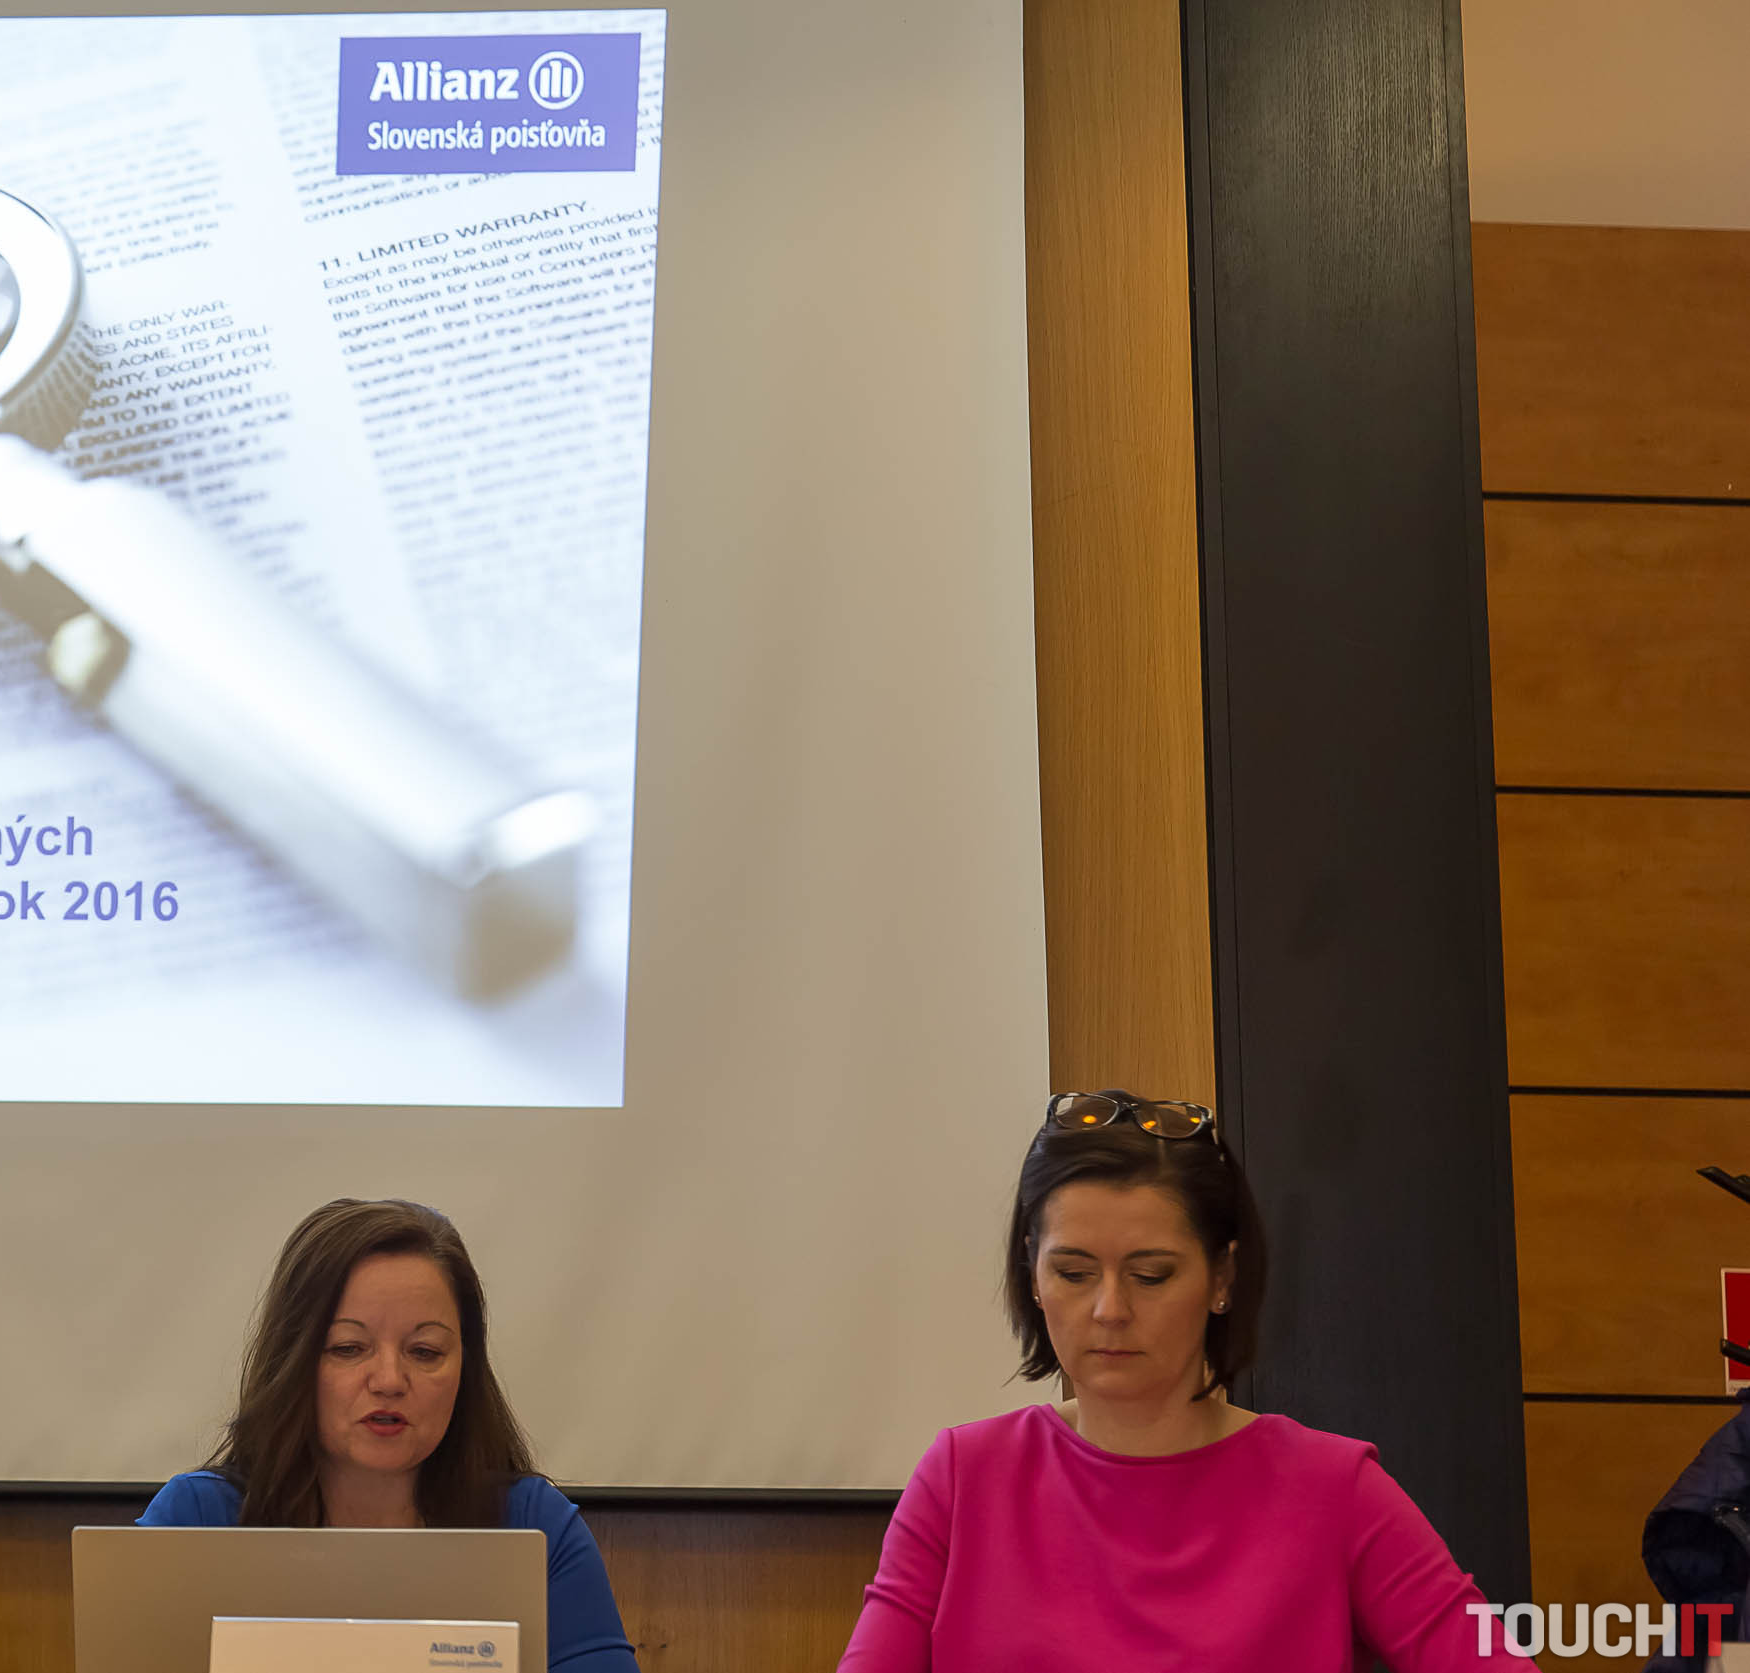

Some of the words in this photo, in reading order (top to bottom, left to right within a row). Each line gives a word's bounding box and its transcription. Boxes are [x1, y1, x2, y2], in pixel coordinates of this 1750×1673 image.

[369, 61, 519, 101] Allianz
[368, 119, 483, 151] Slovenská
[490, 118, 606, 155] poisťovňa
[305, 188, 439, 222] communications
[323, 269, 381, 288] Except
[388, 264, 406, 273] as
[413, 254, 447, 267] may
[454, 248, 476, 258] be
[482, 229, 562, 251] otherwise
[570, 210, 642, 234] provided
[358, 234, 448, 261] LIMITED
[328, 290, 370, 304] rants
[376, 285, 393, 293] to
[399, 277, 425, 288] the
[432, 256, 508, 280] individual
[539, 242, 582, 256] entity
[590, 232, 621, 245] that
[333, 310, 359, 321] the
[365, 291, 440, 313] Software
[447, 284, 466, 293] for
[475, 276, 505, 287] use
[512, 269, 532, 279] on
[540, 248, 635, 273] Computers
[129, 313, 174, 330] ONLY
[182, 301, 231, 318] WAR-
[339, 310, 427, 338] agreement
[435, 301, 466, 313] that
[474, 296, 500, 305] the
[507, 278, 582, 296] Software
[476, 290, 608, 323] Documentation
[124, 334, 160, 349] AND
[167, 316, 234, 339] STATES
[182, 340, 209, 353] ITS
[155, 353, 223, 377] EXCEPT
[232, 344, 269, 359] FOR
[112, 410, 136, 422] TO
[143, 402, 174, 415] THE
[184, 383, 250, 407] EXTENT
[126, 386, 160, 401] ANY
[62, 880, 180, 922] 2016
[429, 1641, 475, 1655] Allianz
